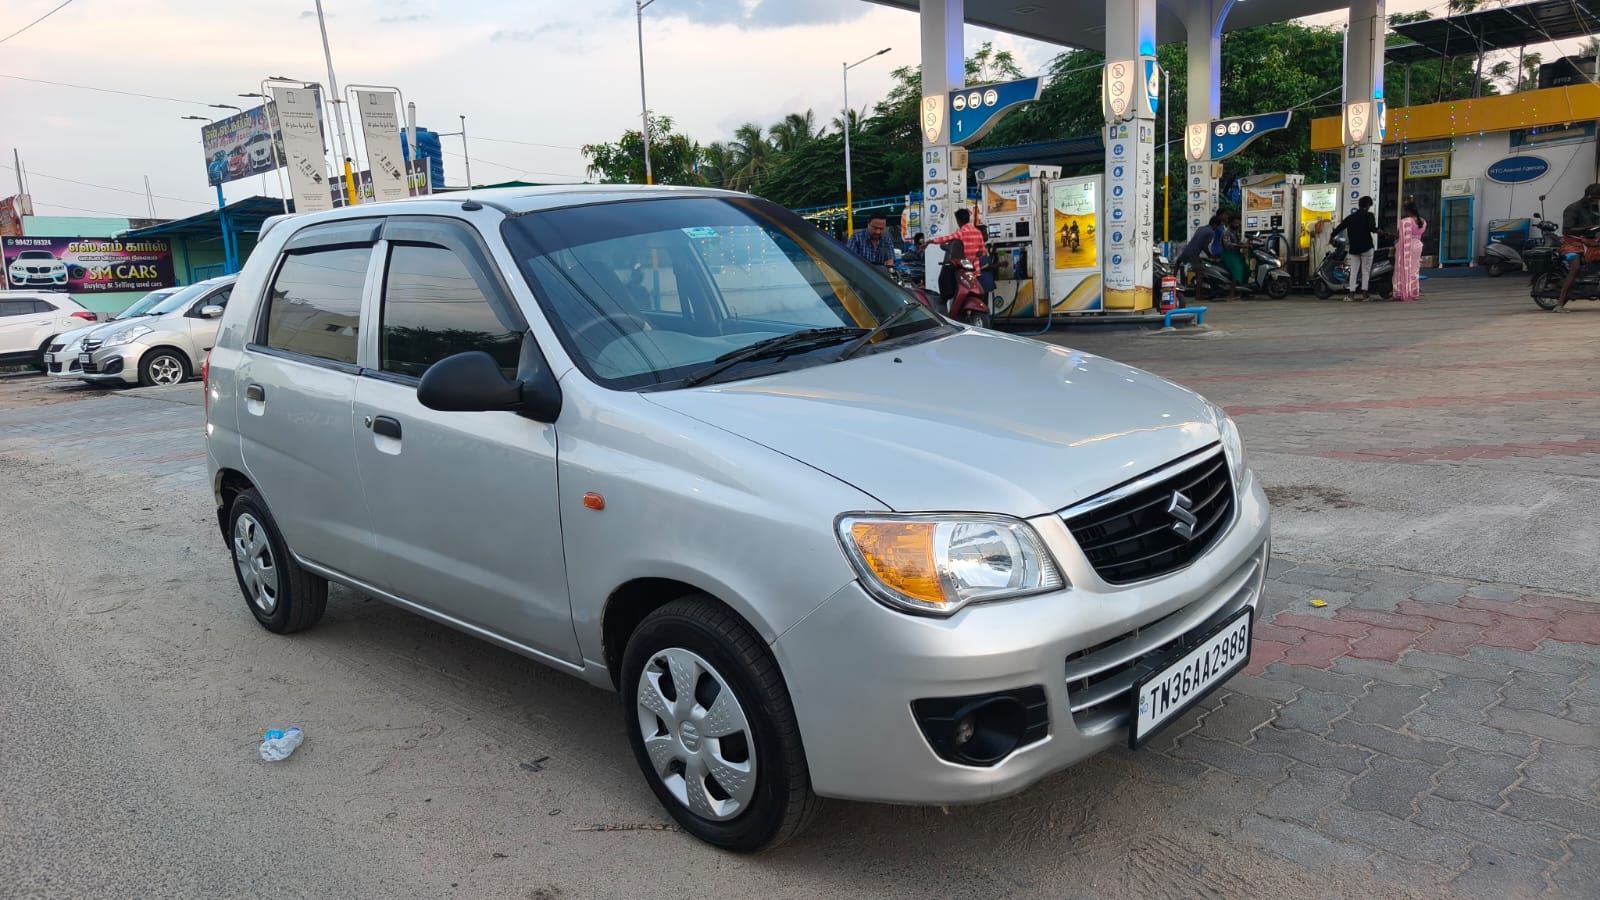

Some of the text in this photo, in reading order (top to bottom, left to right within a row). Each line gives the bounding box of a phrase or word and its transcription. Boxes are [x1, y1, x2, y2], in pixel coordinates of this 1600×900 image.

[956, 120, 962, 132] 1
[1217, 143, 1224, 153] 3
[89, 265, 158, 280] SM CARS
[84, 282, 106, 290] Buying
[114, 281, 135, 289] Selling
[1150, 625, 1246, 719] TN36AA2988
